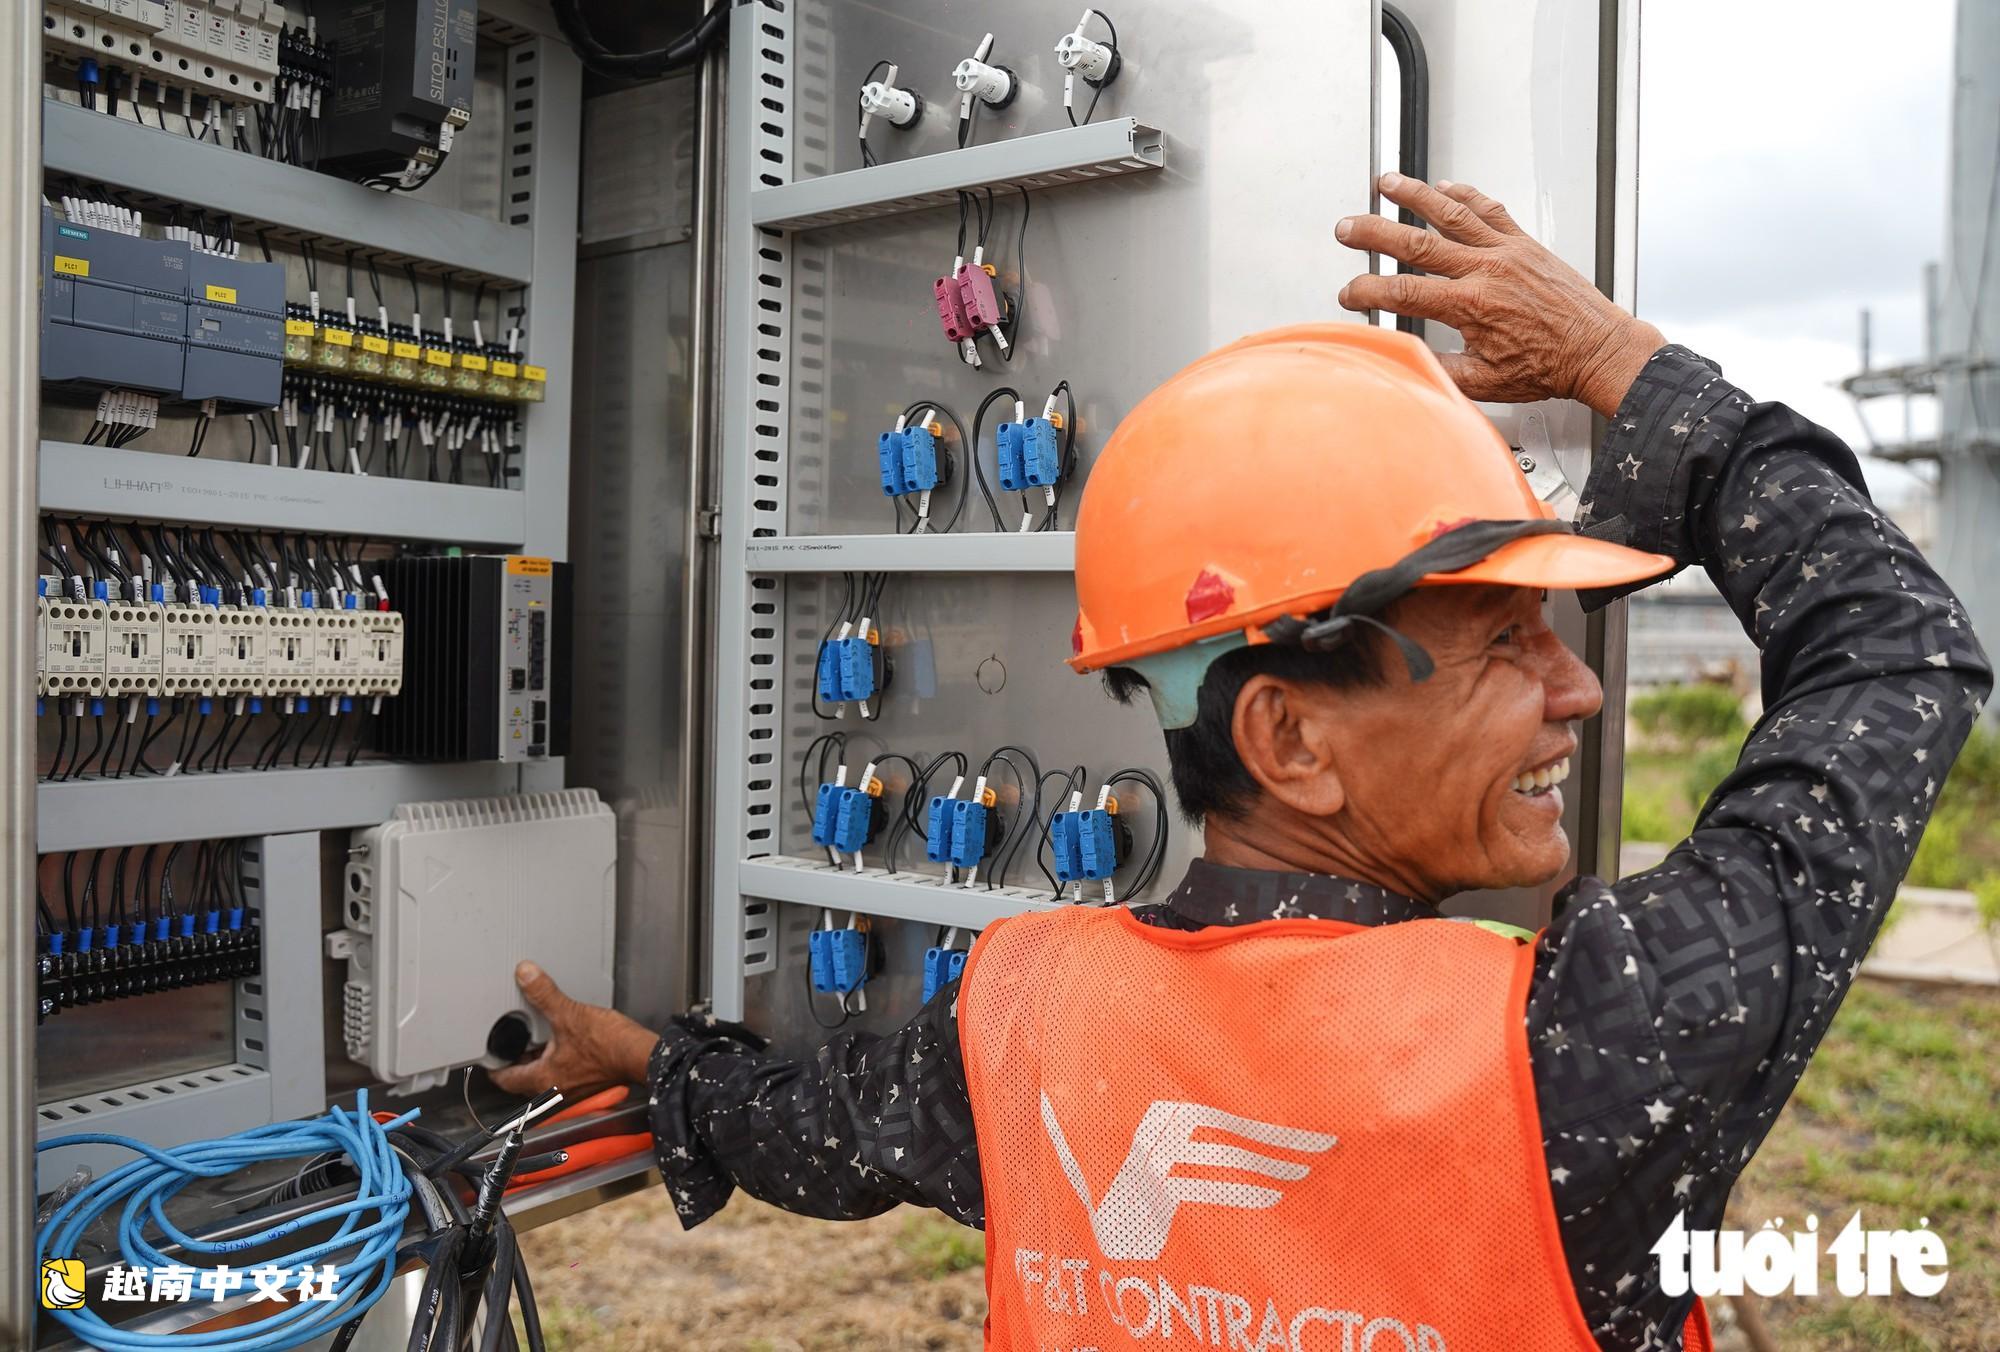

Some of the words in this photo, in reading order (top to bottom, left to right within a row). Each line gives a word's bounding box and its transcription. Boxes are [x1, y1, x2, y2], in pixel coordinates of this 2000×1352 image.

[431, 52, 444, 100] SITOP
[61, 228, 88, 240] SIEMENS
[63, 262, 78, 270] PLC1
